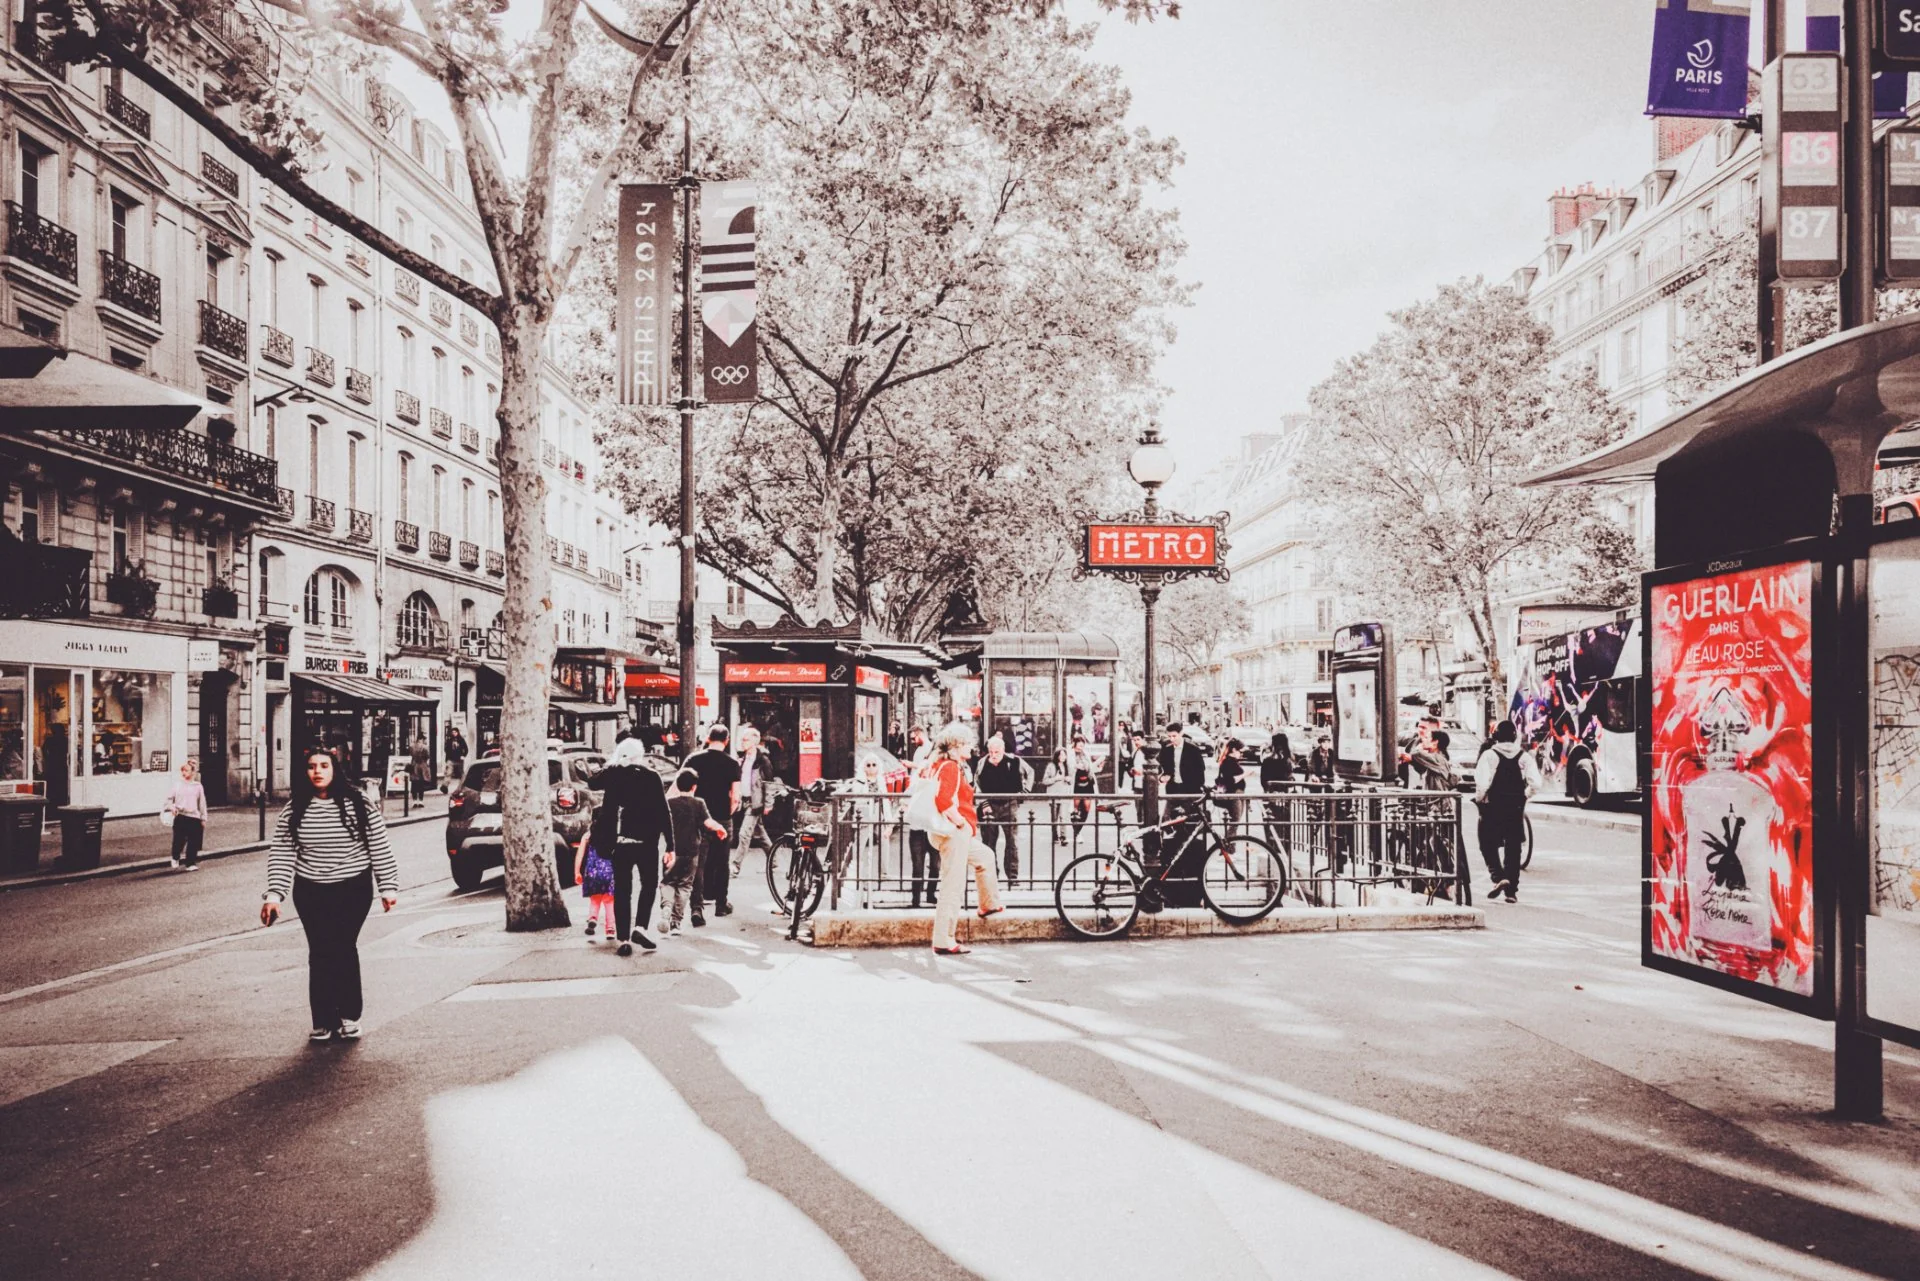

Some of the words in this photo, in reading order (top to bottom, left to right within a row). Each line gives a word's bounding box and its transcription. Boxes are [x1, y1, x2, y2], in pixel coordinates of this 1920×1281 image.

[1675, 68, 1723, 84] PARIS
[1790, 62, 1829, 90] 63
[1789, 135, 1831, 165] 86
[1788, 210, 1831, 238] 87
[635, 201, 656, 282] 2024
[1098, 532, 1207, 559] METRO
[1706, 559, 1742, 573] JCDecaux
[1663, 574, 1799, 626] GUERLAIN
[1709, 620, 1739, 635] PARIS
[1537, 644, 1567, 662] HOP-ON
[1723, 639, 1764, 662] ROSE
[305, 656, 338, 672] BURGER
[348, 660, 368, 674] FRIES
[1537, 659, 1570, 677] HOP-OFF
